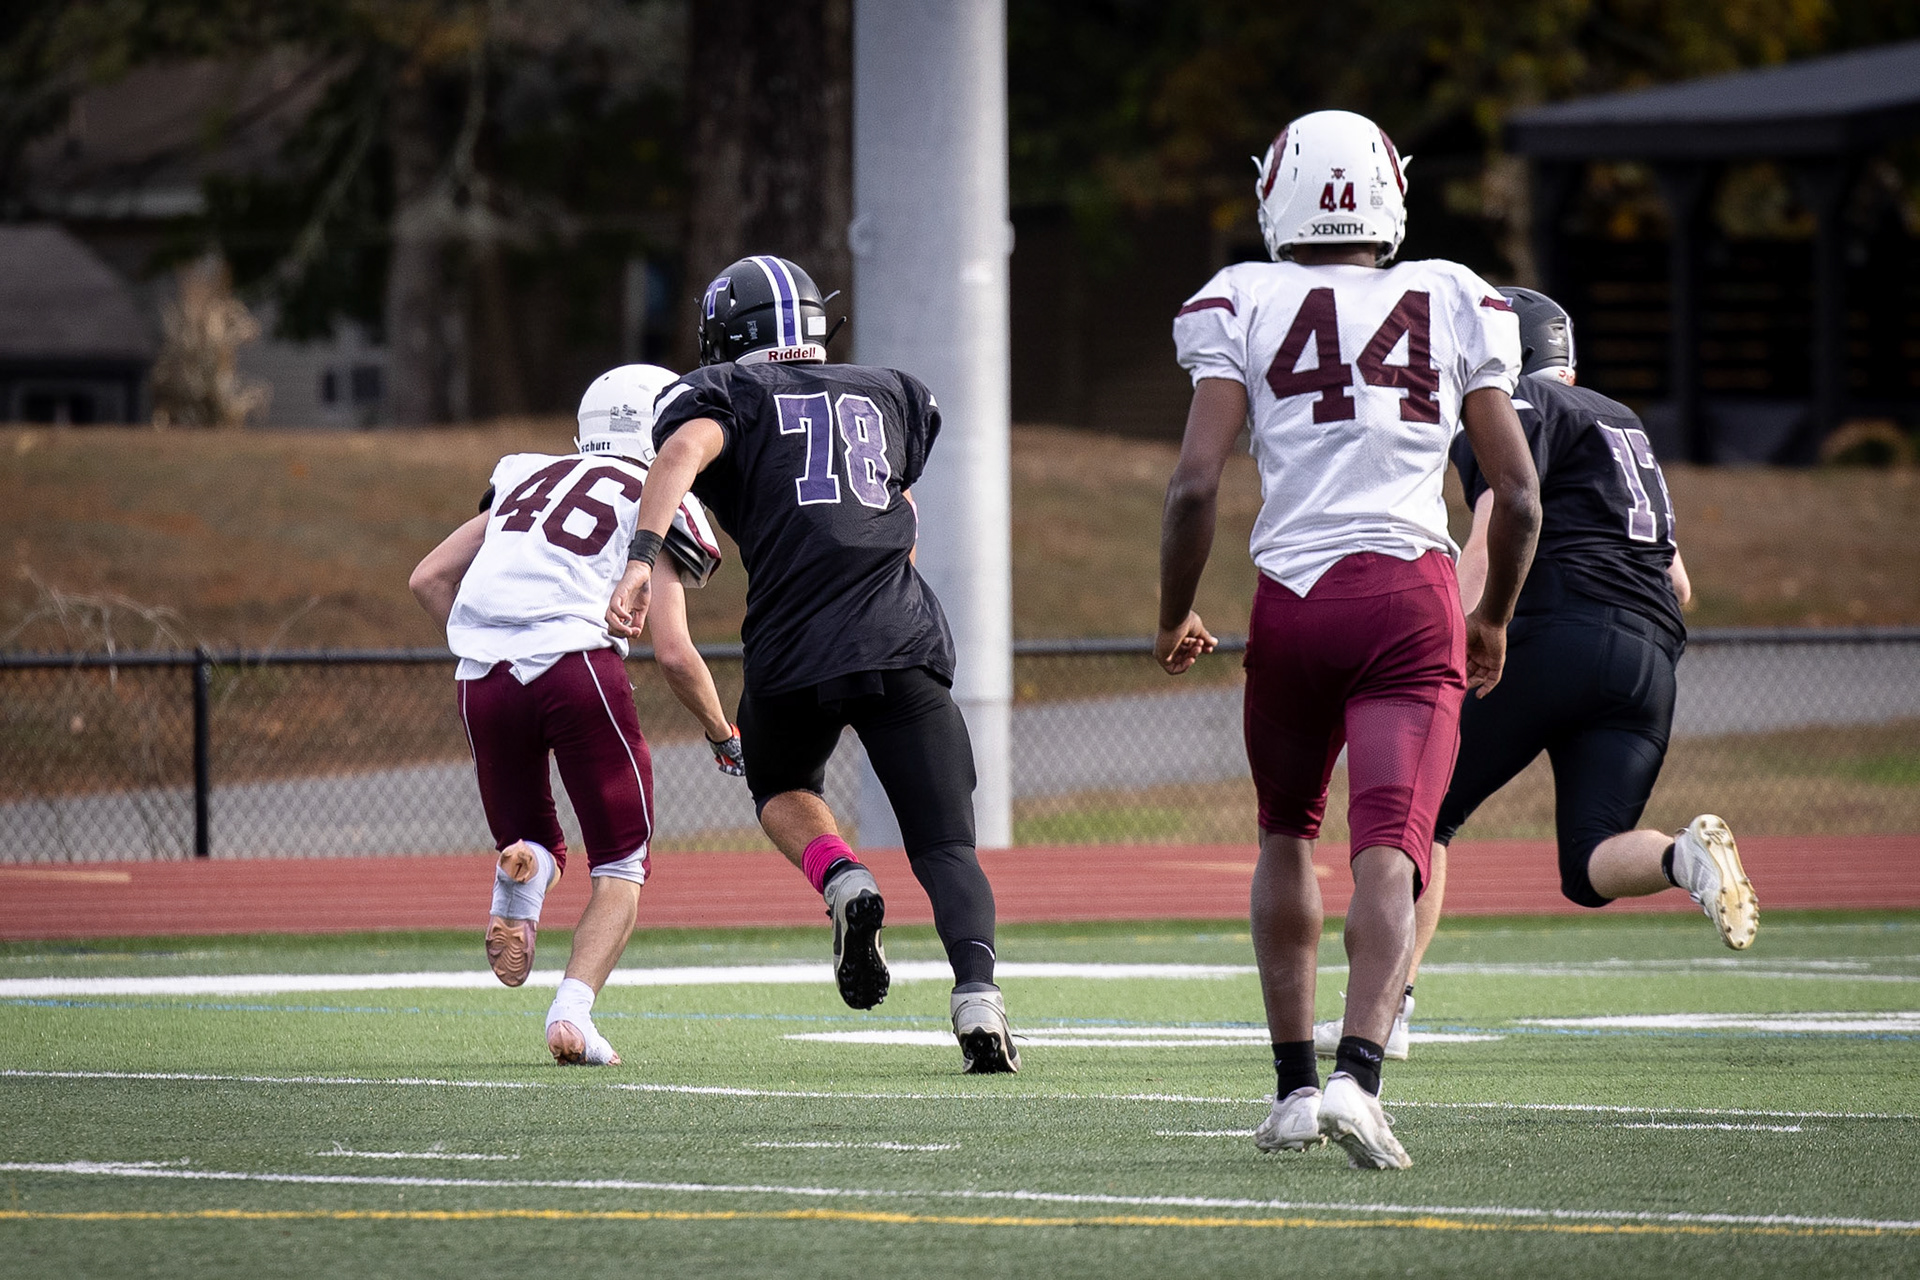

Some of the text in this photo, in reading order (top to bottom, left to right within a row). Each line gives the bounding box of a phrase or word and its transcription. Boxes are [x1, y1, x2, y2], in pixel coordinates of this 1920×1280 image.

[1319, 182, 1357, 212] 44
[1311, 223, 1364, 236] XENITH
[768, 347, 816, 361] Riddell
[1266, 287, 1440, 425] 44
[581, 441, 611, 453] schutt
[773, 391, 892, 510] 78
[495, 459, 643, 557] 46
